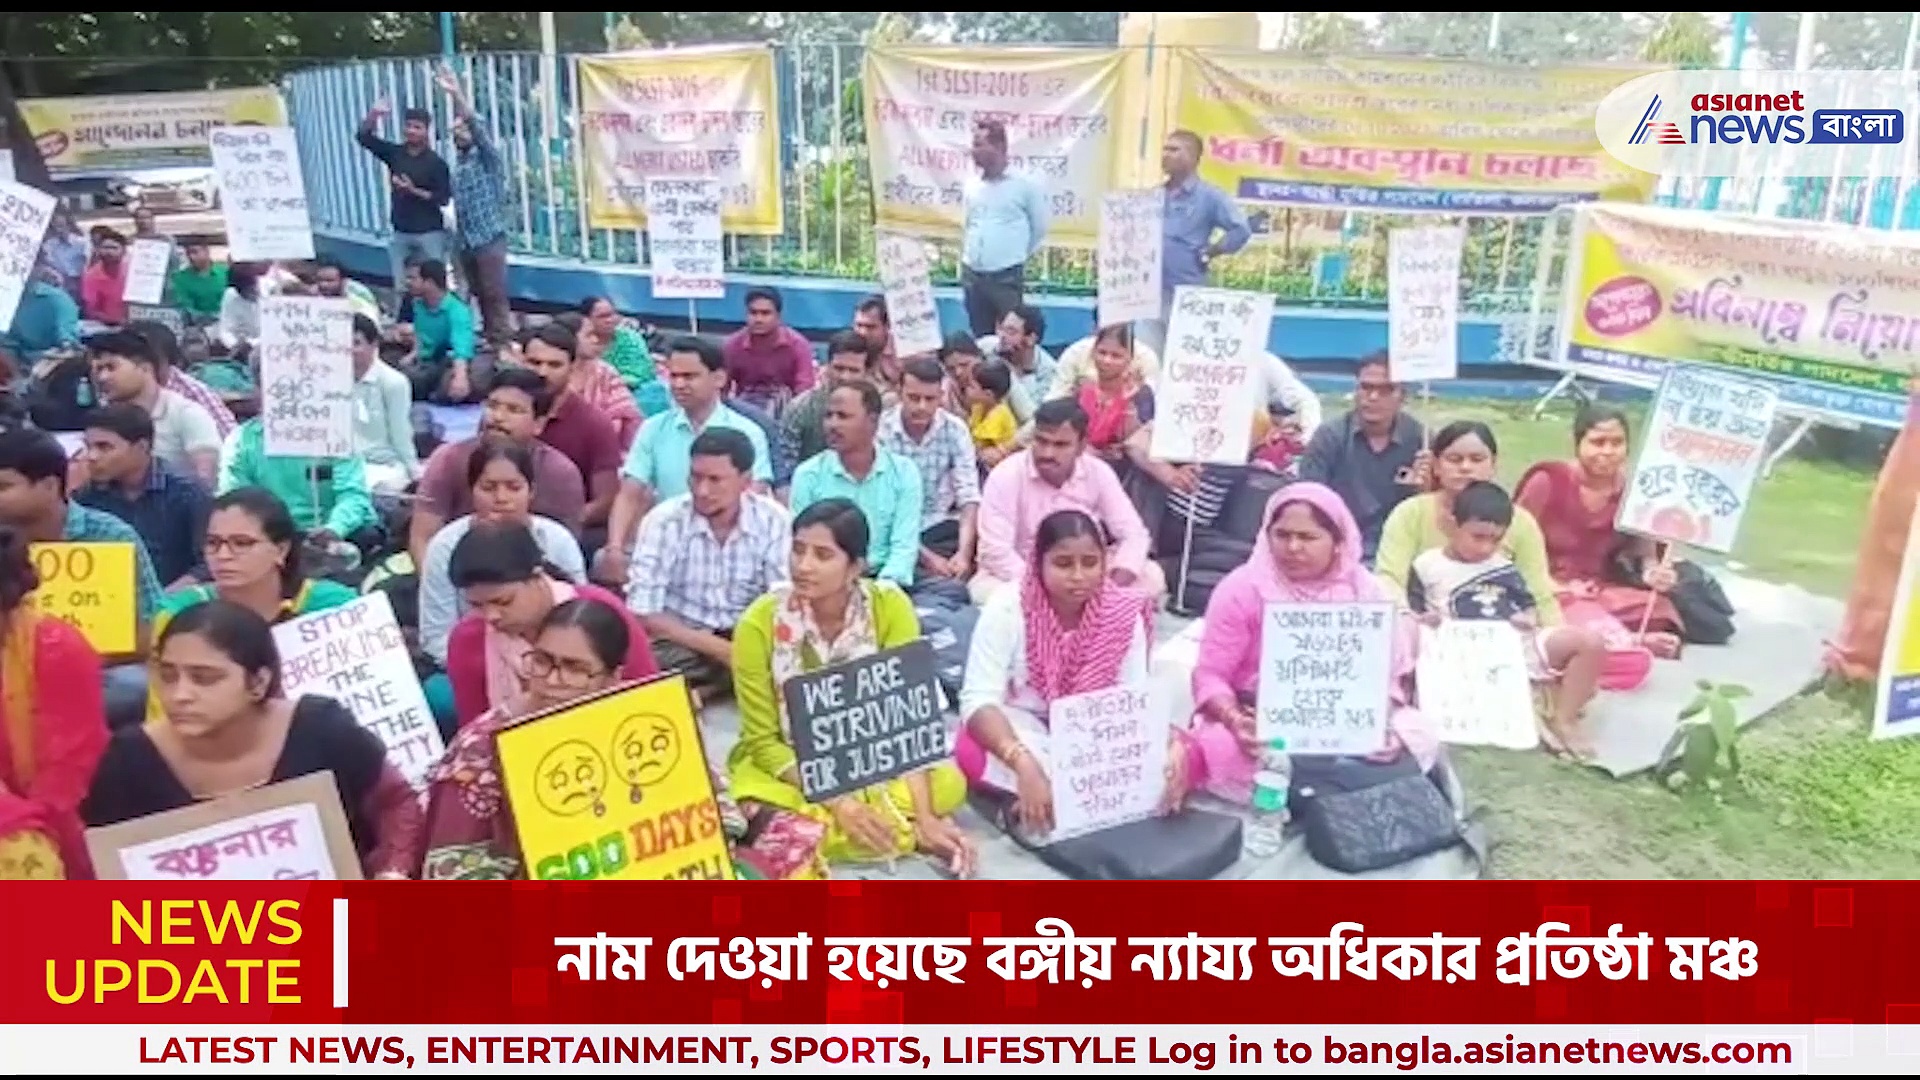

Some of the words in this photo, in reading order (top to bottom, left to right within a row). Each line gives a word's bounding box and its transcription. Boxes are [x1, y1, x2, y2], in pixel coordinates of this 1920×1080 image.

[915, 68, 937, 92] 1st
[942, 69, 1030, 98] SLST-2016
[1298, 145, 1469, 183] অবস্থান
[1670, 275, 1807, 344] অবিলম্বে
[1820, 288, 1920, 361] নিয়ো
[37, 547, 95, 582] 00
[298, 602, 368, 643] STOP
[281, 621, 400, 690] BREAKING
[326, 661, 374, 692] THE
[802, 673, 845, 715] WE
[855, 656, 906, 701] ARE
[811, 683, 932, 752] STRIVING
[800, 755, 841, 796] FOR
[847, 721, 944, 781] JUSTICE
[149, 818, 308, 878] বঞ্চনার
[536, 831, 630, 880] 600
[628, 798, 719, 863] DAYS
